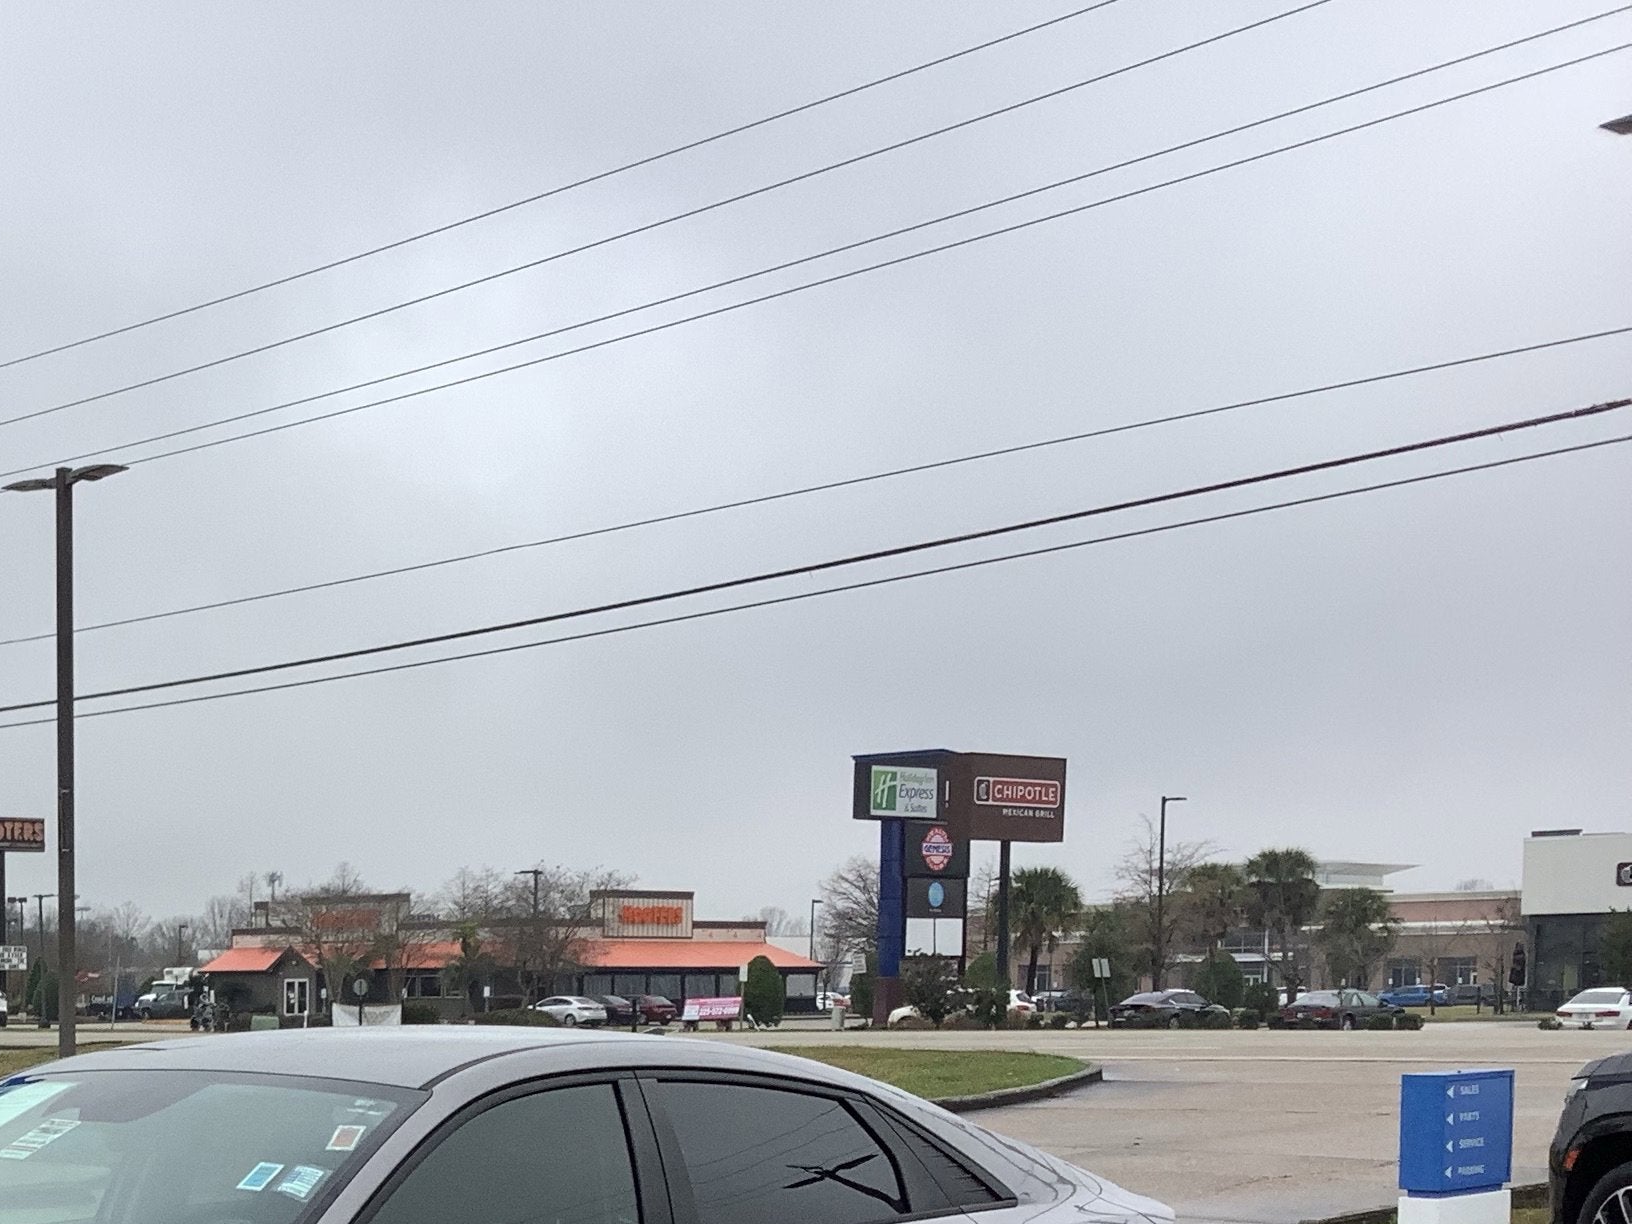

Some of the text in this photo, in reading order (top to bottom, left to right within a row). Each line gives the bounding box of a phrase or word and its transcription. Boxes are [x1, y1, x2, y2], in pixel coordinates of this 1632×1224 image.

[899, 783, 934, 801] Express
[994, 784, 1056, 801] CHIPOTLE
[1002, 808, 1055, 819] MEXICAN GRILL
